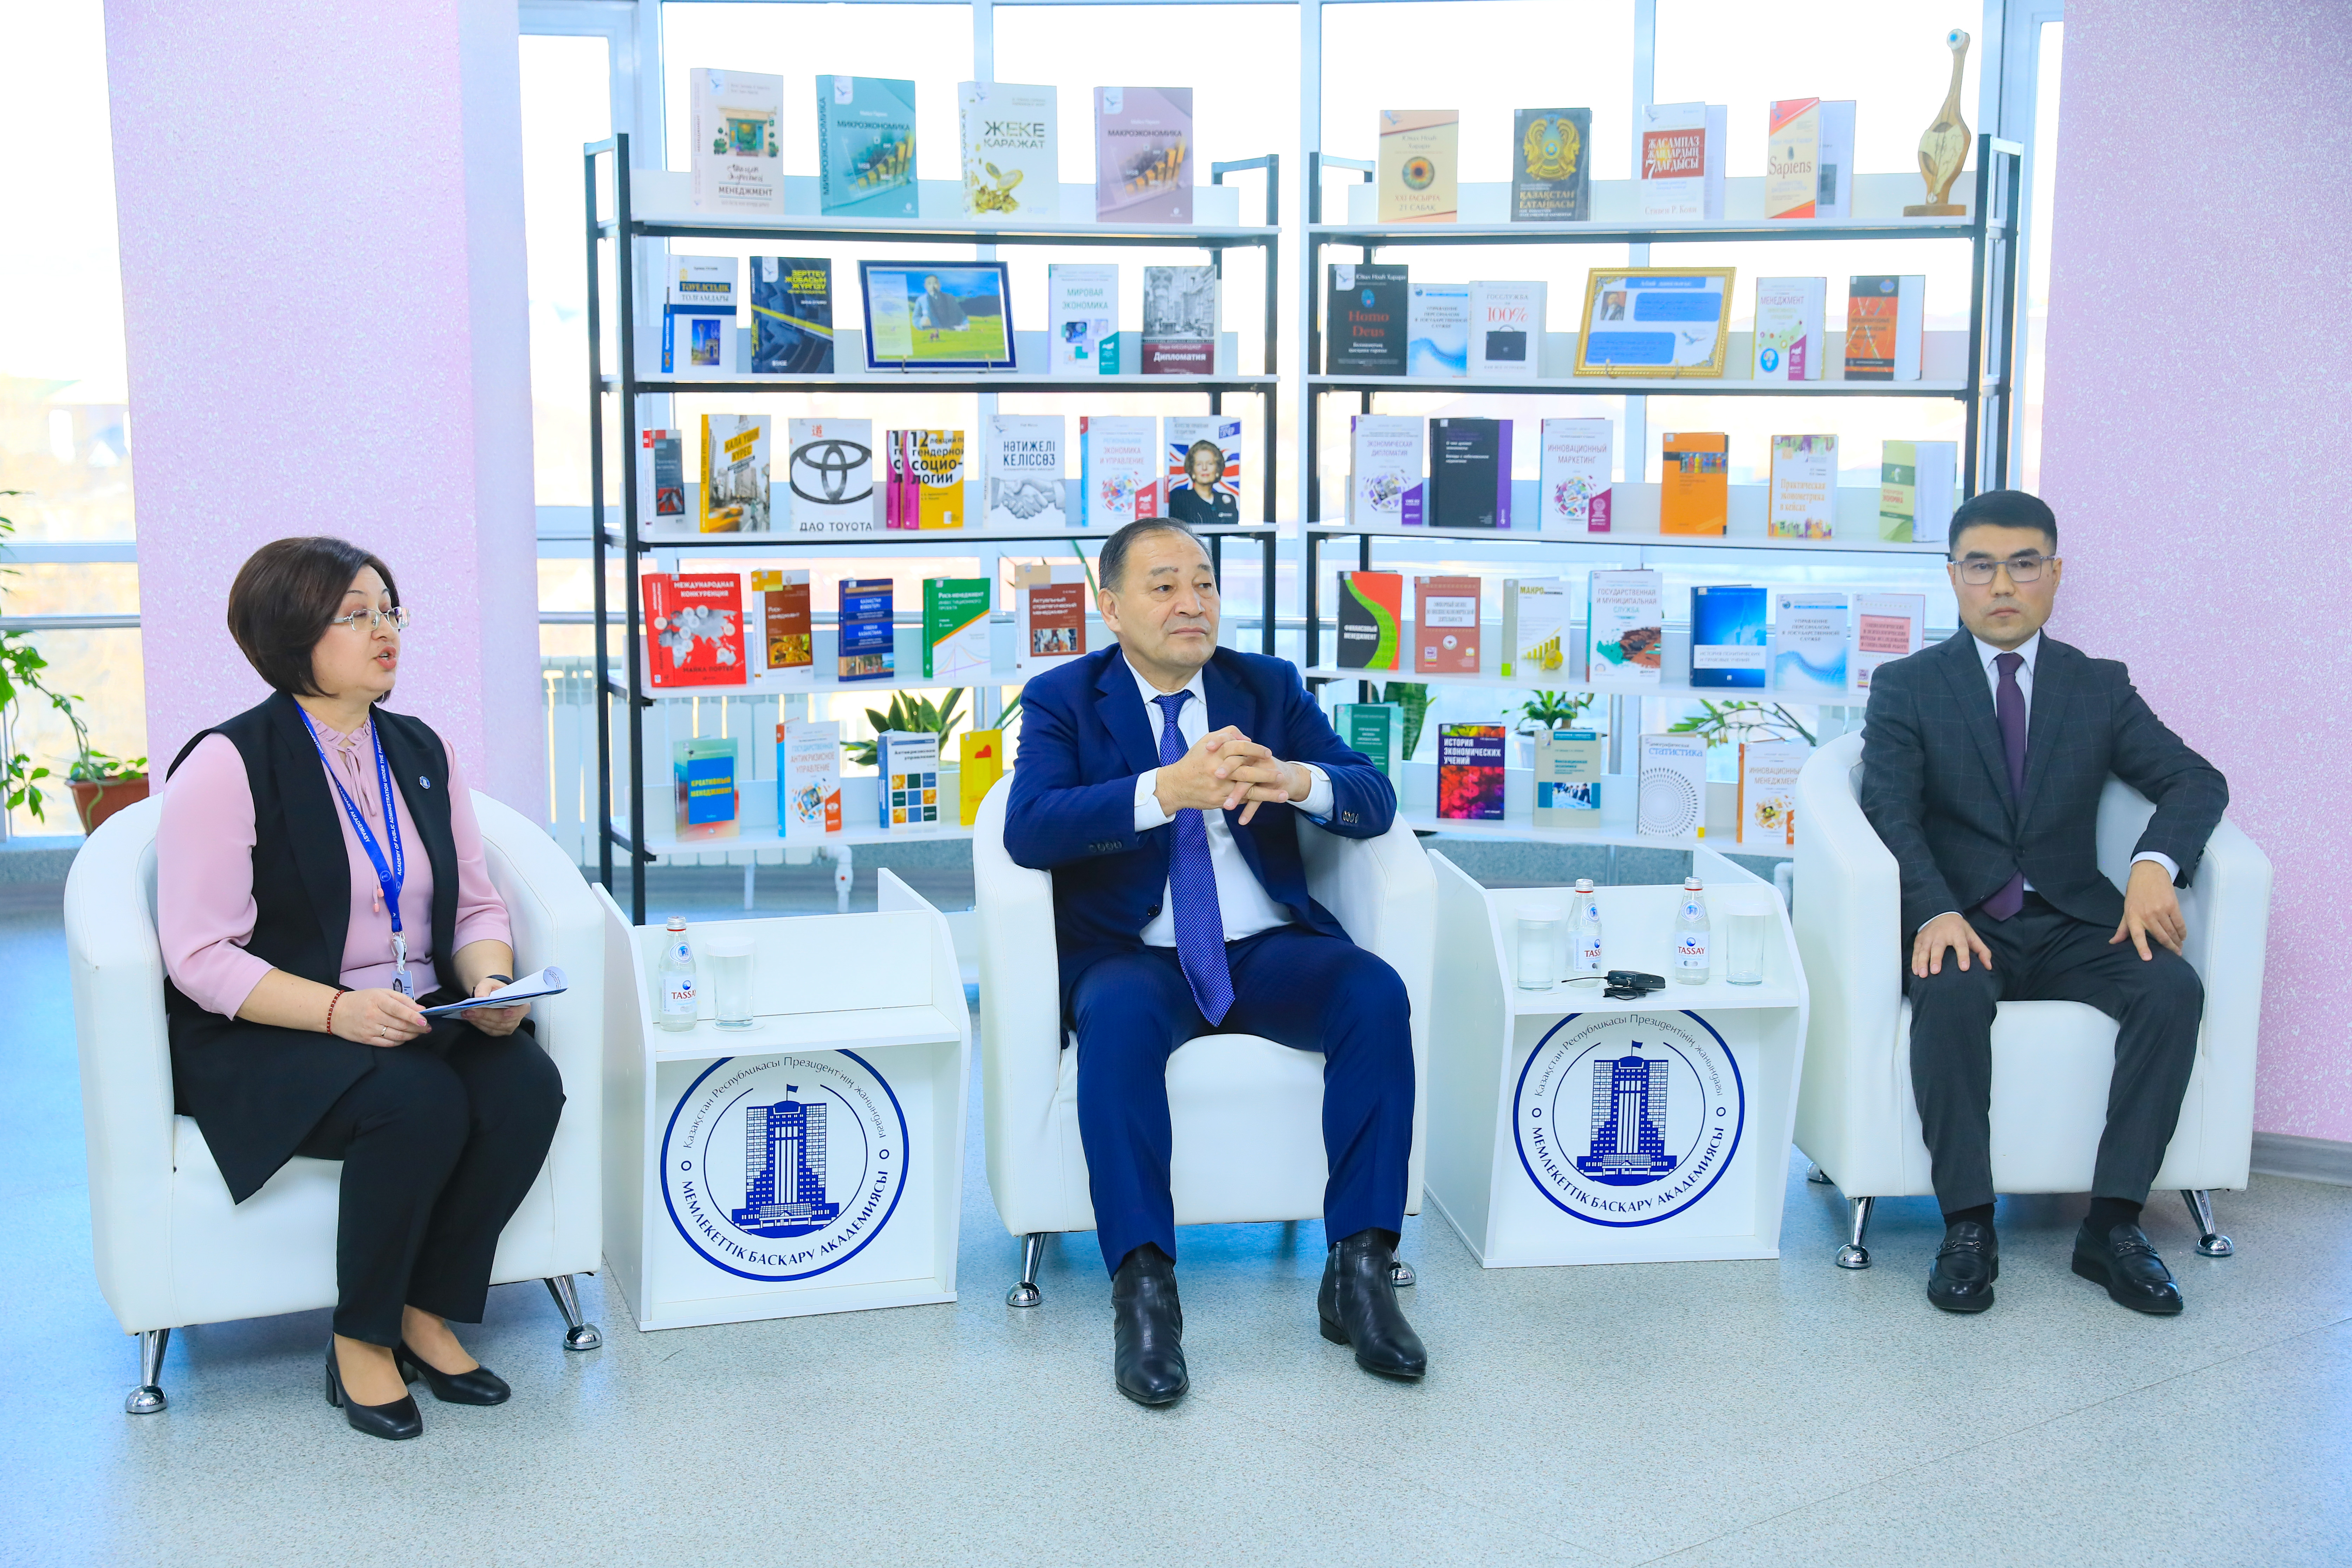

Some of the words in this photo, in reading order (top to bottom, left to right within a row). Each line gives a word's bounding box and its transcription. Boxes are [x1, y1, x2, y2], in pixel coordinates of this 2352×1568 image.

[837, 120, 910, 131] МИКРОЭКОНОМИКА
[984, 121, 1045, 137] ЖЕКЕ
[819, 97, 829, 195] МИКРОЭКОНОМИКА
[1648, 136, 1700, 149] ЖАСАМПАЗ
[1645, 160, 1657, 180] 7
[1769, 156, 1812, 179] Sapiens
[719, 187, 772, 196] МЕНЕДЖМЕНТ
[1761, 296, 1804, 305] МЕНЕДЖМЕНТ
[1348, 311, 1389, 322] Homo
[1486, 306, 1528, 323] 100%
[1353, 325, 1384, 337] Deus
[1153, 352, 1206, 362] Дипломатия
[812, 425, 823, 437] 道
[912, 432, 928, 447] 12
[1004, 441, 1055, 451] НӘТИЖЕЛІ
[1548, 444, 1606, 453] ИННОВАЦИОННЫЙ
[1003, 454, 1055, 466] КЕЛІССӨЗ
[1558, 455, 1596, 464] МАРКЕТИНГ
[912, 459, 963, 472] социо-
[912, 474, 953, 484] логии
[1781, 479, 1825, 490] Практическая
[1786, 503, 1806, 512] кейсах
[800, 523, 824, 531] ДАО
[830, 522, 872, 531] TOYOTA
[1520, 586, 1544, 594] МАКРО
[1344, 624, 1378, 633] ФИНАНСОВЫЙ
[1444, 738, 1473, 747] ИСТОРИЯ
[791, 751, 834, 763] АНТИКРИЗИСНОЕ
[1444, 747, 1501, 757] ЭКОНОМИЧЕСКИХ
[1649, 747, 1703, 757] статистика
[1444, 756, 1470, 765] УЧЕНИЙ
[796, 763, 829, 773] УПРАВЛЕНИЕ
[691, 787, 732, 797] МЕНЕДЖМЕНТ
[383, 782, 394, 824] ADMINISTRATION
[350, 811, 370, 843] AKADEMIASY
[394, 841, 400, 850] OF
[1584, 948, 1601, 957] TASS
[1678, 946, 1705, 954] TASSAY
[1535, 1050, 1564, 1096] Қазақстан
[1562, 1017, 1627, 1050] Республикасы
[1630, 1014, 1695, 1048] Президентінің
[683, 1099, 714, 1148] Қазақстан
[712, 1060, 780, 1098] Республикасы
[1532, 1127, 1588, 1205] МЕМЛЕКЕТТІК
[1590, 1197, 1653, 1213] БАСҚАРУ
[1657, 1127, 1724, 1206] АКАДЕМИЯСЫ
[682, 1181, 748, 1260] МЕМЛЕКЕТТІК
[749, 1248, 815, 1266] БАСҚАРУ
[820, 1171, 888, 1257] АКАДЕМИЯСЫ
